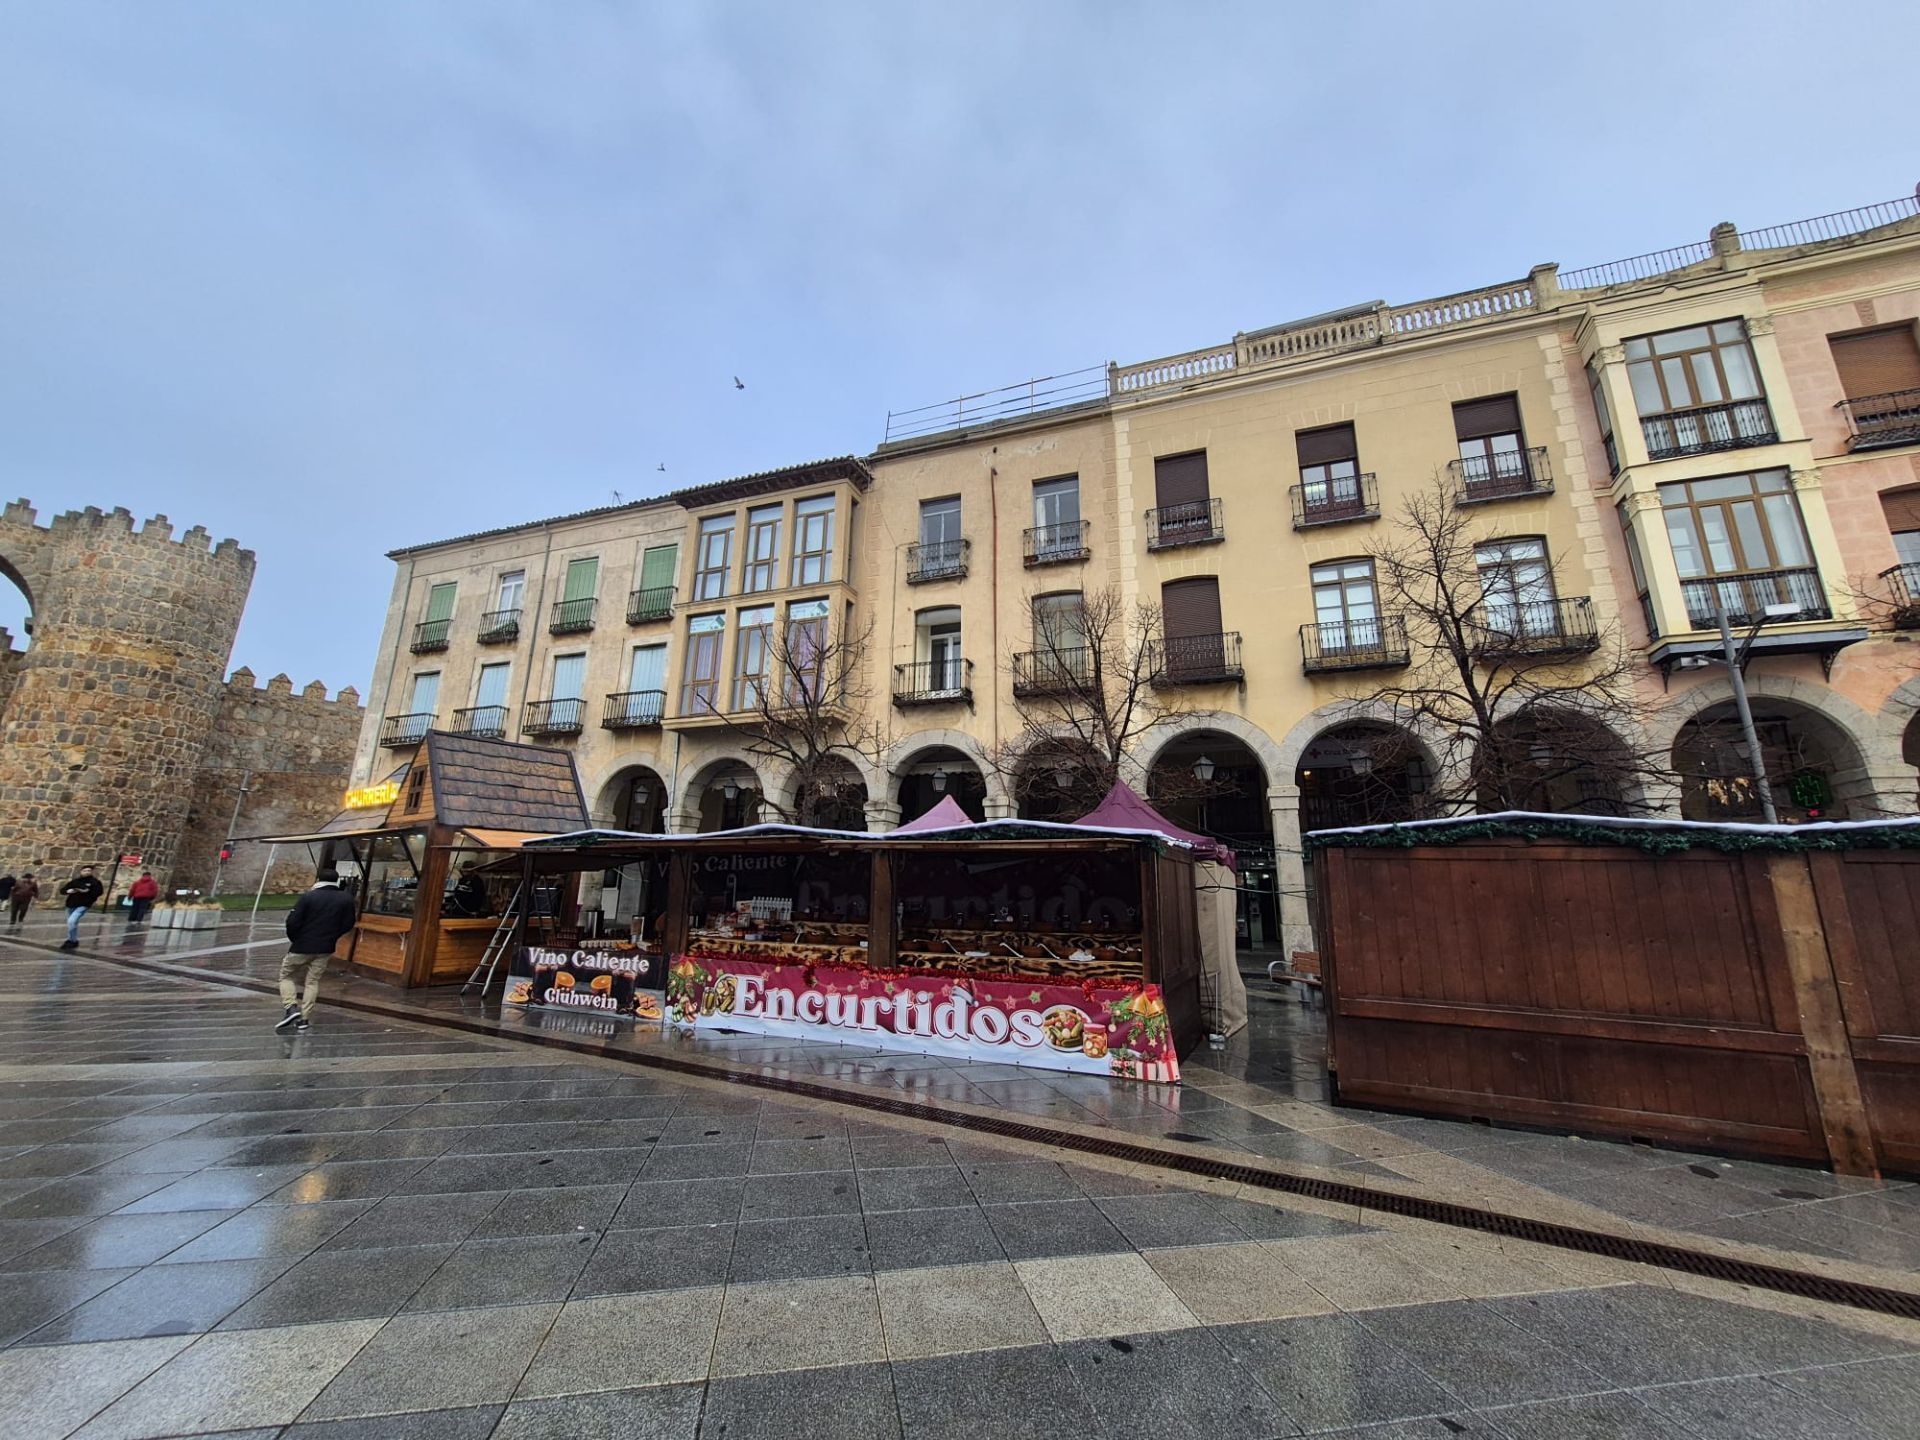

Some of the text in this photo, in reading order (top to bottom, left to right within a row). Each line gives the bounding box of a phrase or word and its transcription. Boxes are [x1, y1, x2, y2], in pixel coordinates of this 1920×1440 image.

[704, 853, 789, 873] Caliente
[528, 947, 650, 972] Vino Caliente
[543, 987, 618, 1011] Glühwein
[732, 973, 1046, 1048] Encurtidos
